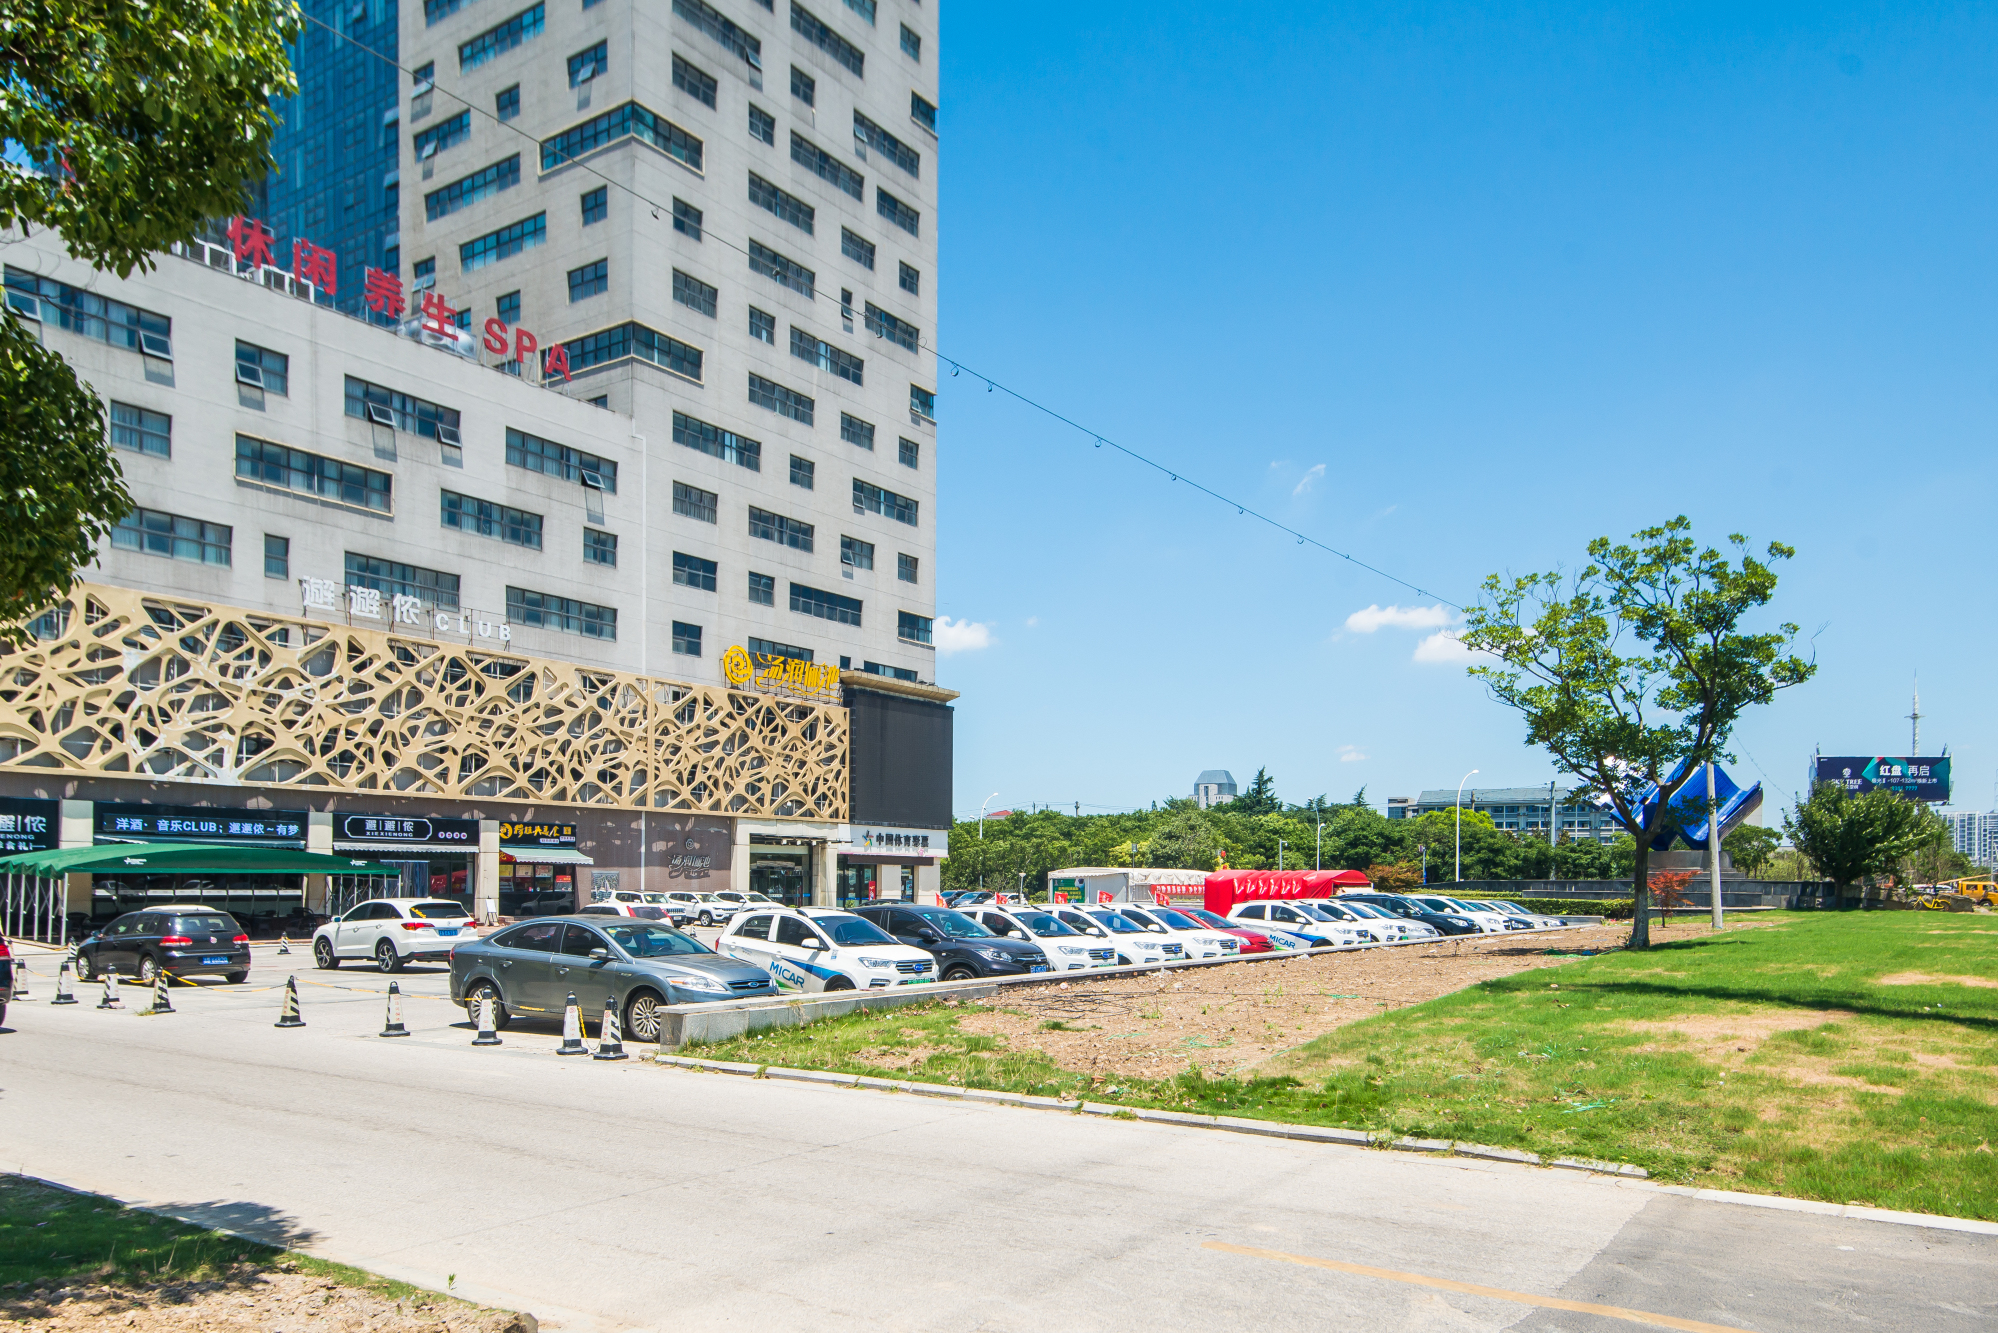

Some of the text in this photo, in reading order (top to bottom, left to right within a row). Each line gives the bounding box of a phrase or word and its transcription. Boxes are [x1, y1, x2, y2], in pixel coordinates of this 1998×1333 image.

[226, 214, 572, 382] 休闲养生 SPA
[436, 613, 512, 641] CLUB
[875, 832, 930, 848] 中国体育彩票
[1269, 934, 1296, 949] MICAR
[769, 960, 805, 989] MICAR
